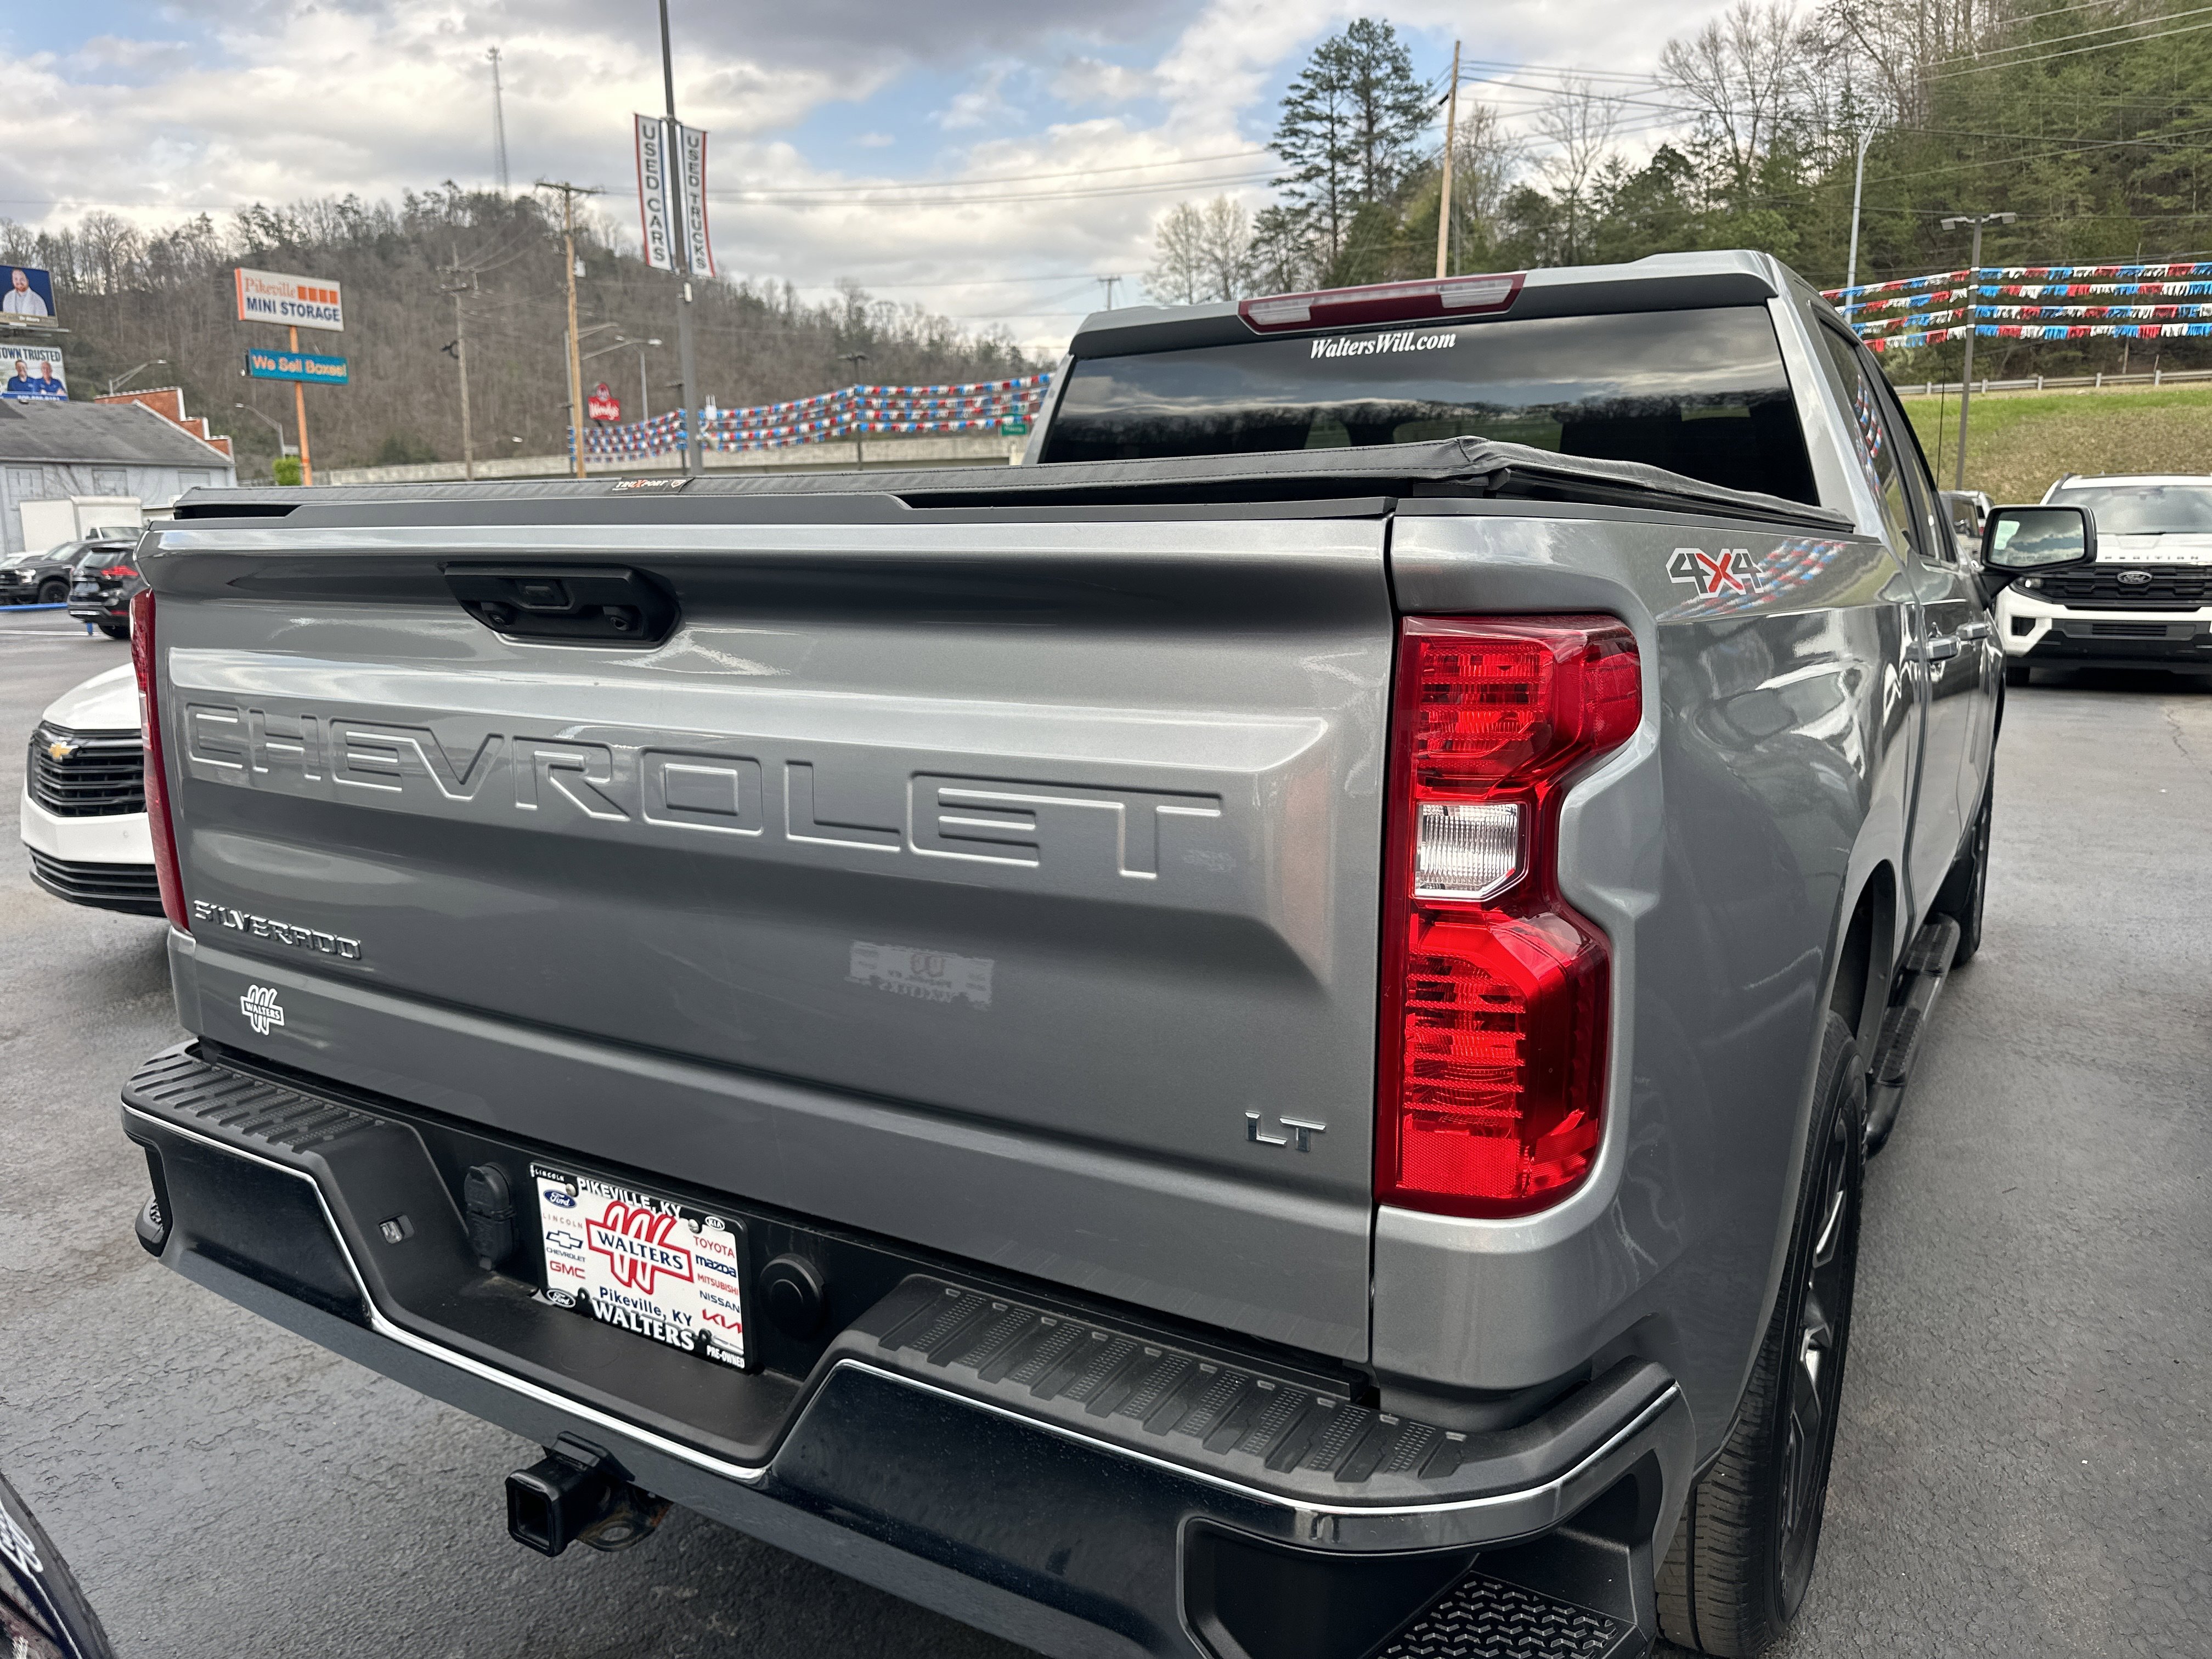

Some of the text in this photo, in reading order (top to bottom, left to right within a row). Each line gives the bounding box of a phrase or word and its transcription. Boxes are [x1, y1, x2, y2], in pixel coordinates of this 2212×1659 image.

[642, 125, 665, 262] USED CARS
[687, 136, 706, 269] USED TRUCKS
[245, 276, 295, 298] Pikeville
[246, 297, 341, 321] MINI STORAGE
[0, 347, 61, 362] OWN TRUSTED
[1310, 331, 1457, 359] WaltersWill.com
[252, 355, 276, 370] We
[279, 357, 302, 373] Sell
[616, 479, 669, 488] TRUXPORT
[185, 703, 1222, 879] CHEVROLET
[194, 899, 362, 960] SILVERADO
[245, 1002, 281, 1020] WALTERS
[1245, 1110, 1326, 1152] LT
[535, 1169, 565, 1182] LINCOLN
[549, 1192, 571, 1207] Ford
[577, 1177, 681, 1220] PIKEVILLE, KY
[543, 1213, 583, 1229] LINCOLN
[707, 1217, 723, 1229] KIA
[546, 1247, 585, 1262] CHEVROLET
[597, 1230, 684, 1270] WALTERS
[693, 1235, 735, 1259] TOYOTA
[550, 1261, 585, 1279] GMC
[697, 1273, 738, 1295] MITSUBISHI
[600, 1286, 692, 1327] Pikeville, KY
[699, 1290, 740, 1313] NISSAN
[591, 1298, 695, 1351] WALTERS
[706, 1345, 745, 1369] PRE-OWNED
